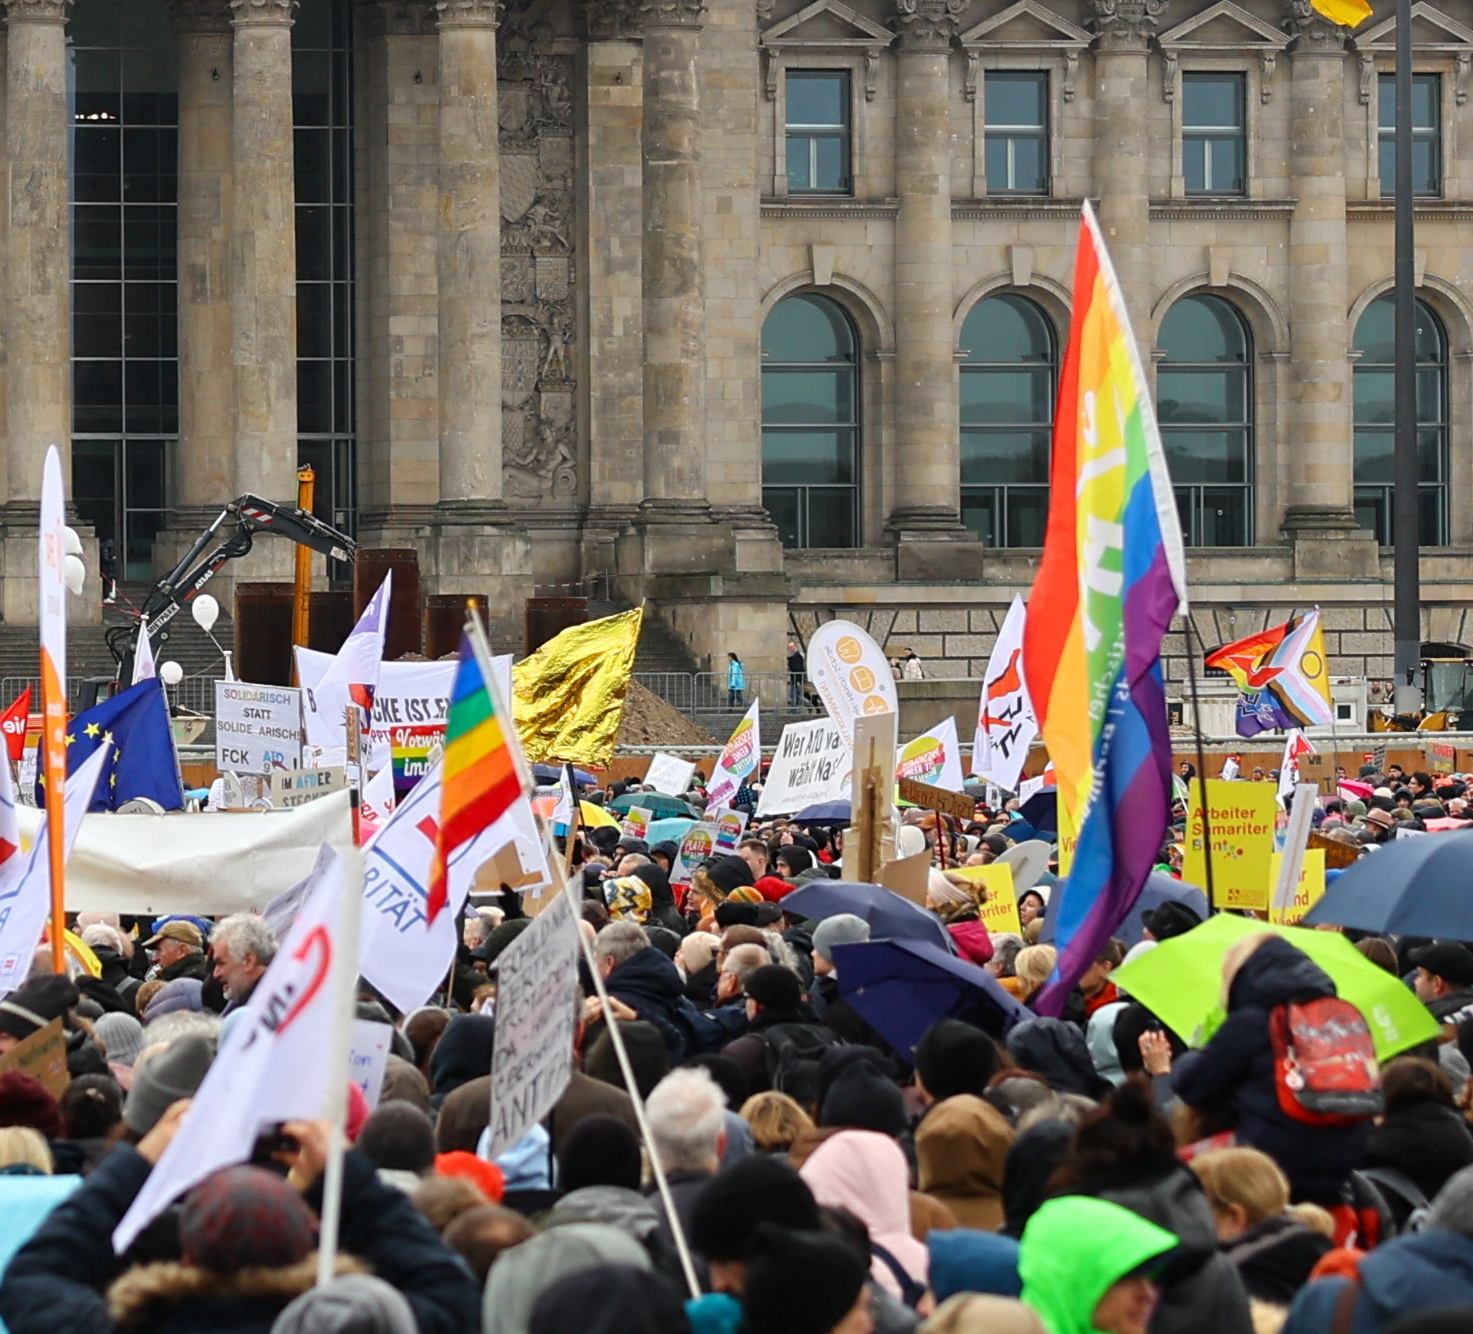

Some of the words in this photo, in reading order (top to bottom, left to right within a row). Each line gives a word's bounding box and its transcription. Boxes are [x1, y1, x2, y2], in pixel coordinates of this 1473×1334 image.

[194, 568, 215, 590] ATLAS
[146, 603, 180, 637] MIETPARK
[223, 687, 292, 706] SOLIDARISCH
[242, 707, 272, 720] STATT
[217, 720, 253, 736] SOLIDE
[258, 725, 302, 742] ARISCH!
[782, 732, 804, 760] Wer
[804, 727, 825, 757] AfD
[221, 749, 250, 766] FCK
[281, 777, 293, 790] IM
[787, 758, 816, 789] wählt
